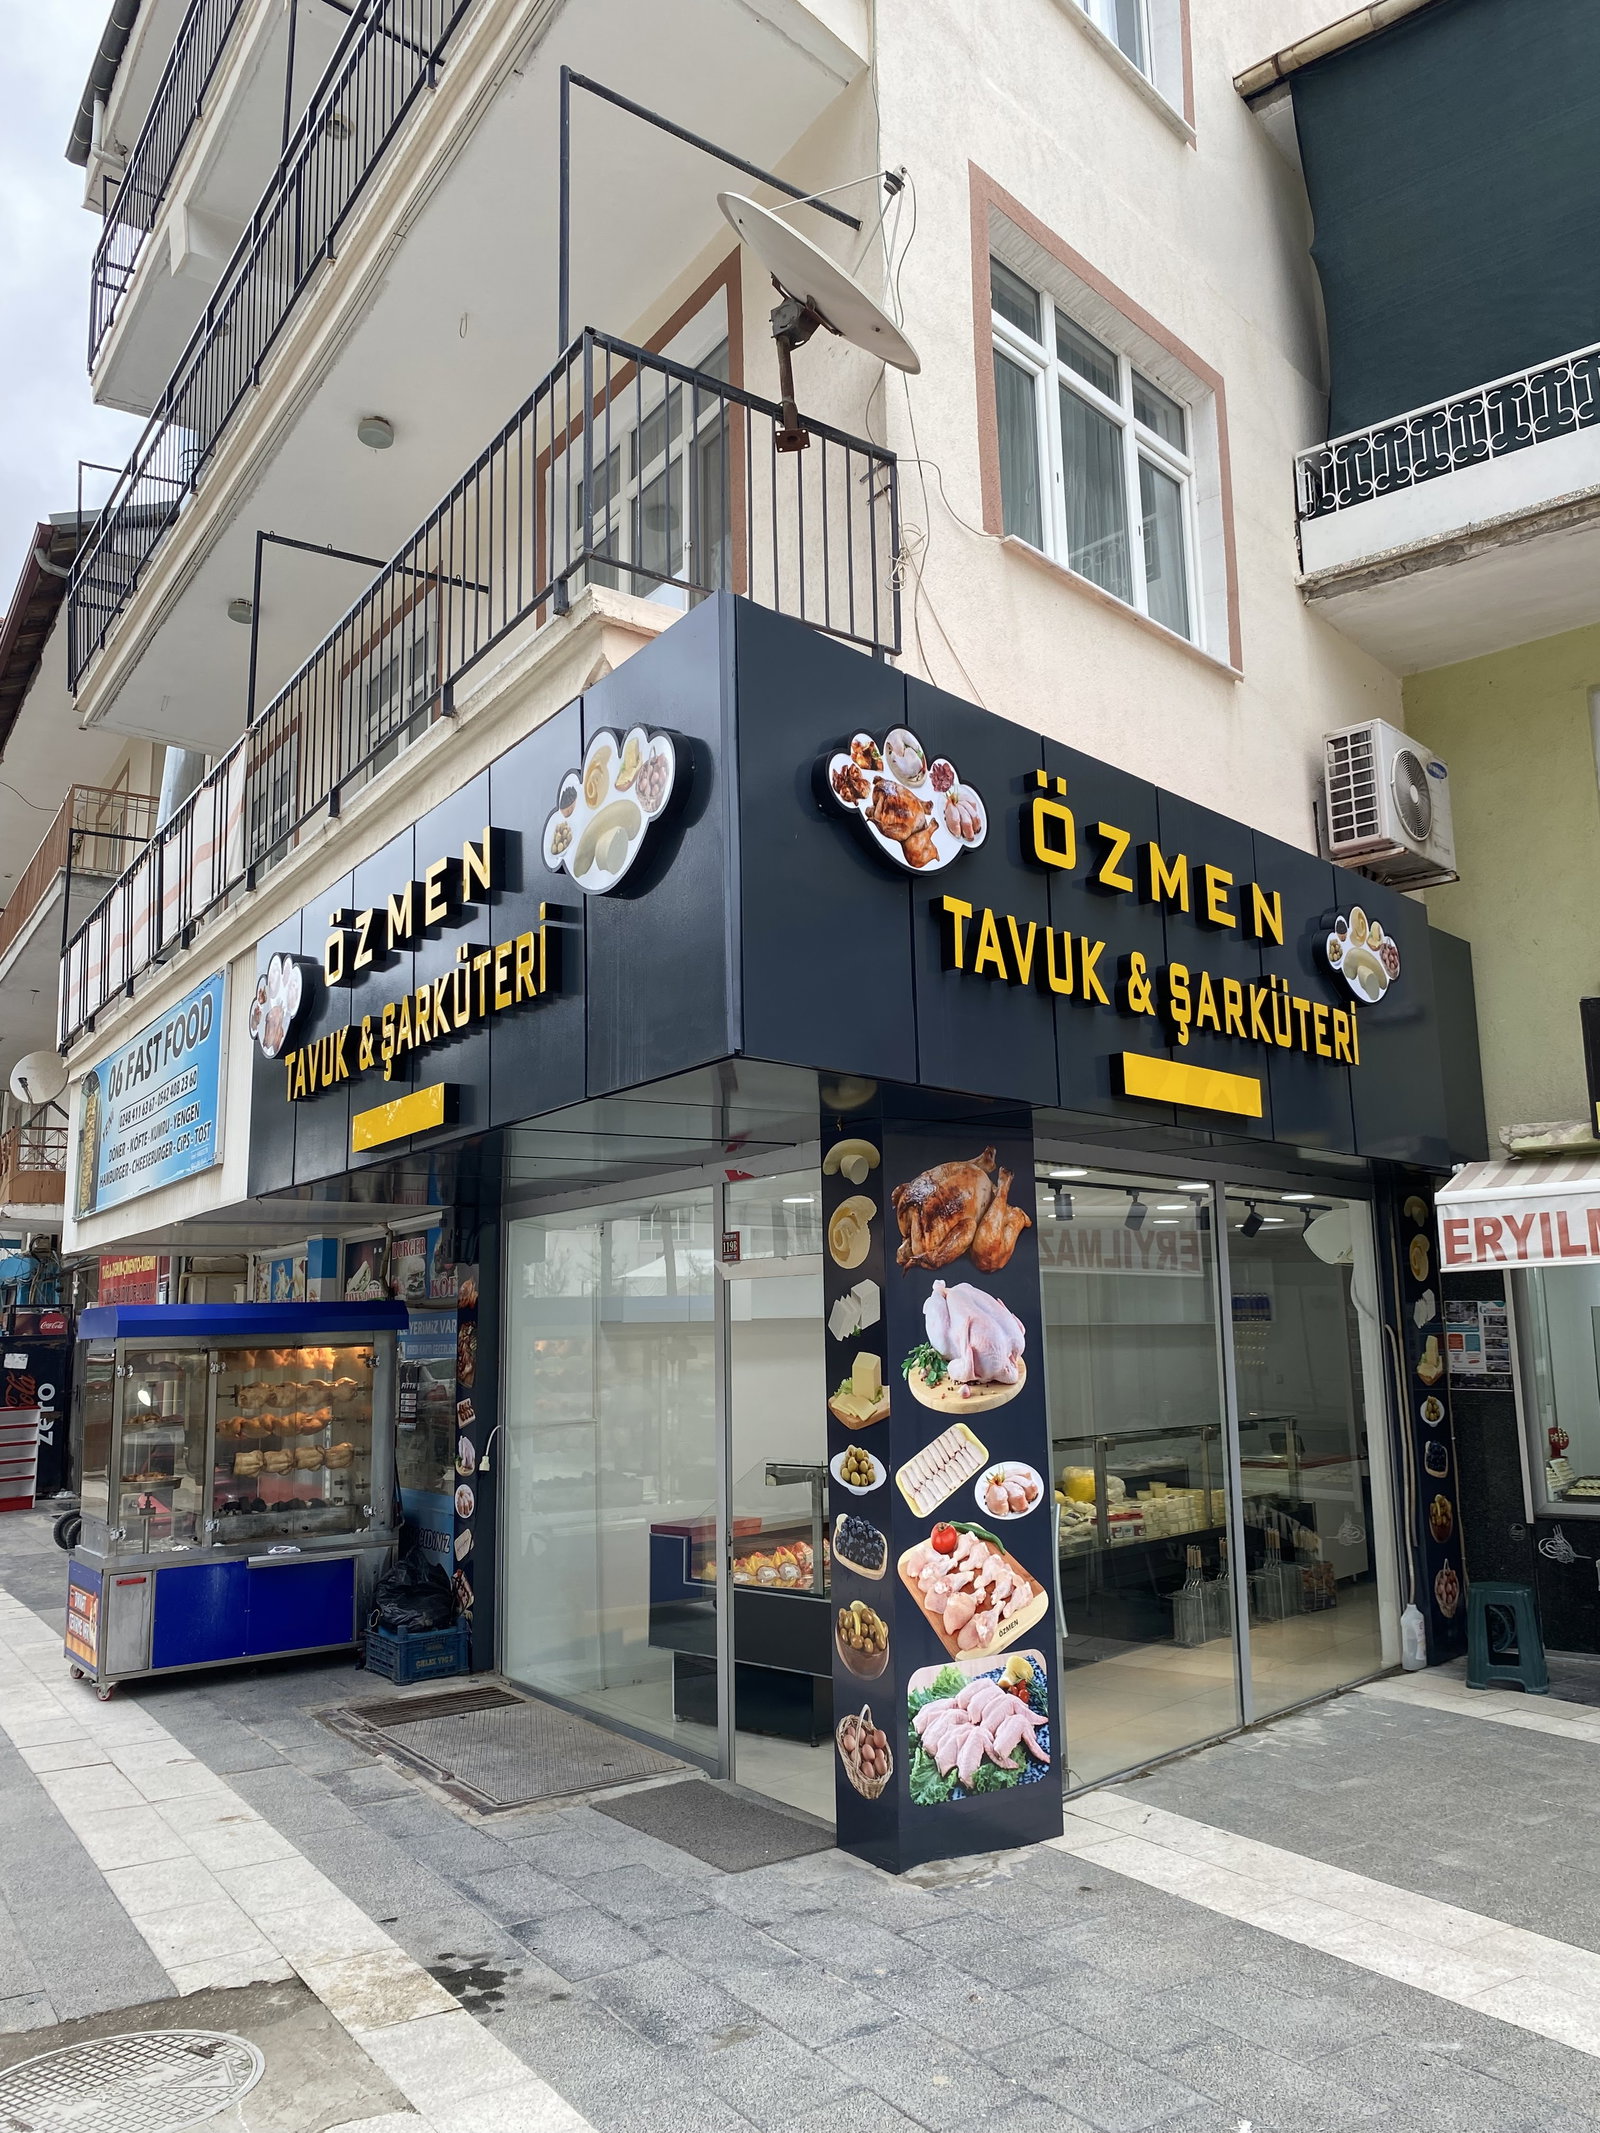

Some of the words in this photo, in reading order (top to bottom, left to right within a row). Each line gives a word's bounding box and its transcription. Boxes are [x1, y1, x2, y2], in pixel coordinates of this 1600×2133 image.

[324, 826, 490, 987] ÖZMEN
[1032, 769, 1283, 946] ÖZMEN
[107, 1063, 123, 1103] 06
[125, 1030, 162, 1091] FAST
[164, 993, 213, 1066] FOOD
[284, 1025, 349, 1102] TAVUK
[358, 1015, 374, 1071] &
[381, 902, 546, 1081] ŞARKÜTERİ
[943, 895, 1110, 1005] TAVUK
[1128, 952, 1156, 1016] &
[1169, 962, 1359, 1066] ŞARKÜTERİ
[98, 1163, 129, 1189] HAMBURGER
[131, 1141, 173, 1174] CHEESEBURGER
[194, 1122, 212, 1144] TOST
[108, 1142, 126, 1163] DÖNER
[130, 1131, 148, 1152] KÖFTE
[173, 1102, 200, 1129] YENGEN
